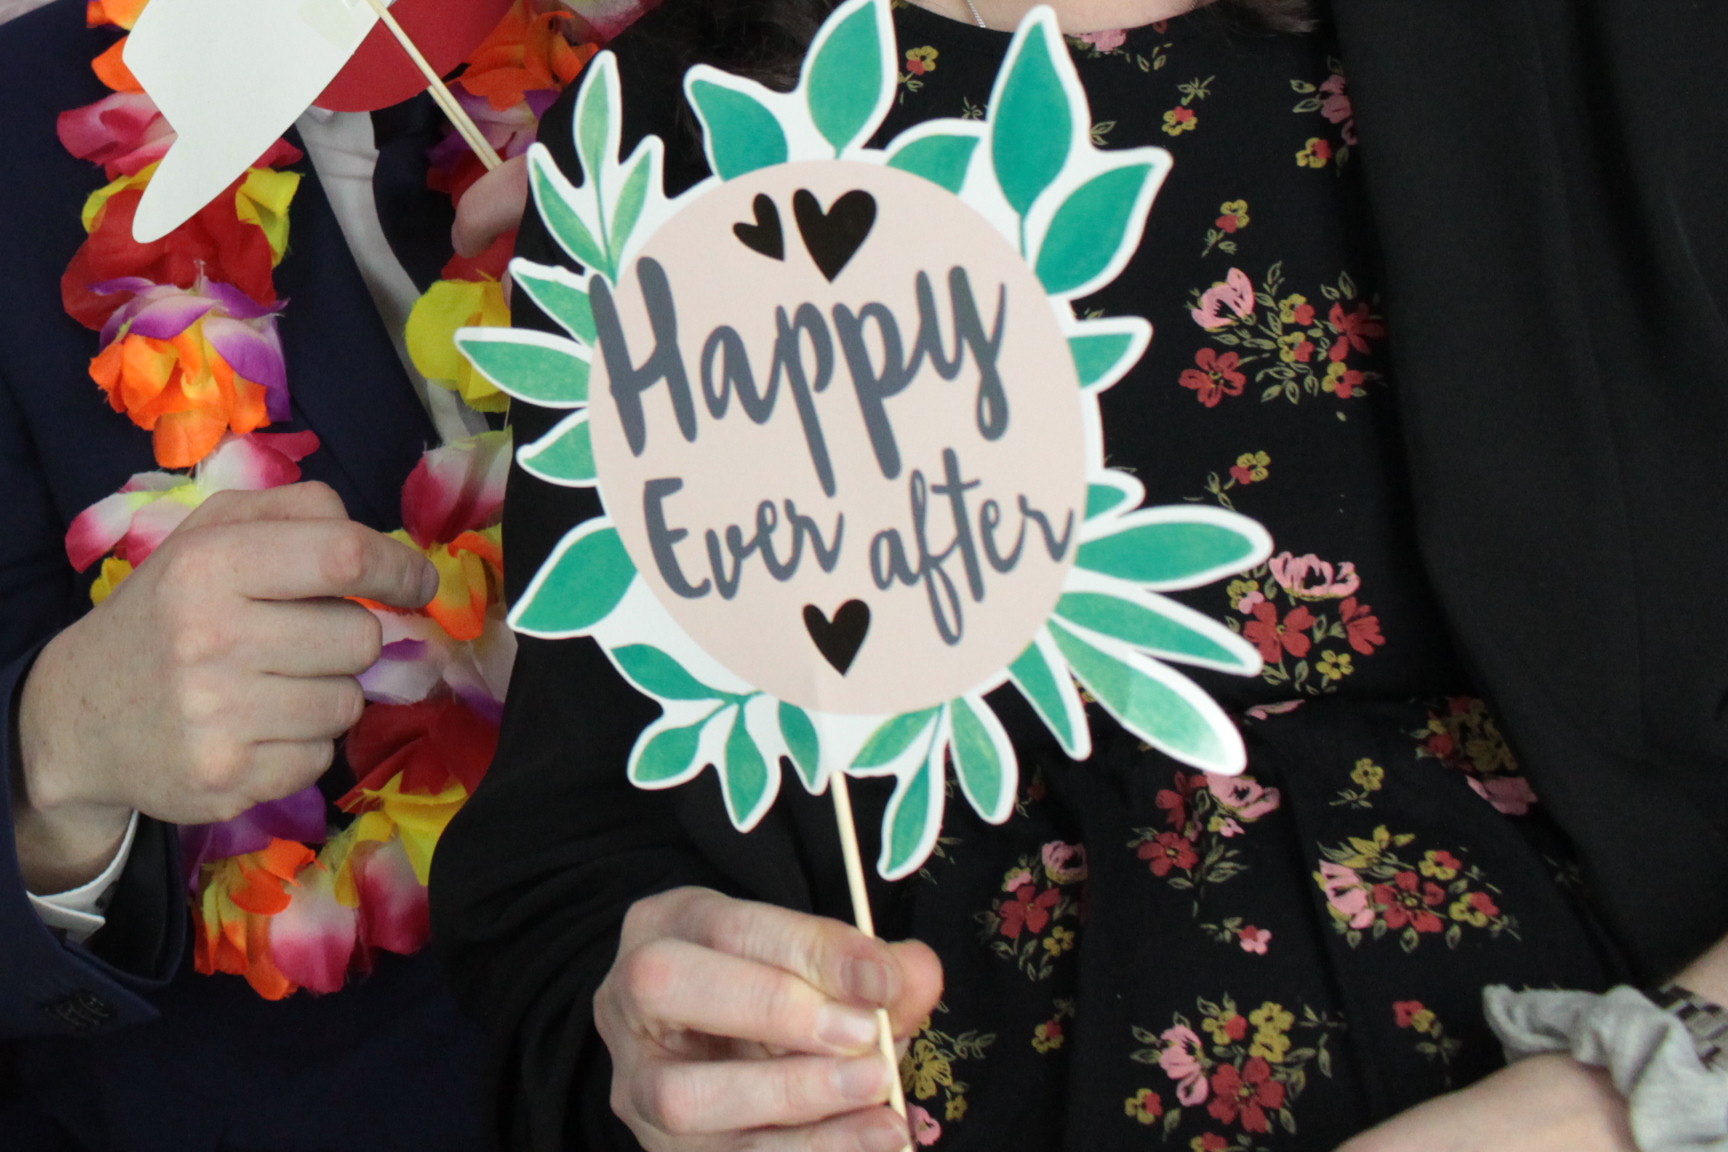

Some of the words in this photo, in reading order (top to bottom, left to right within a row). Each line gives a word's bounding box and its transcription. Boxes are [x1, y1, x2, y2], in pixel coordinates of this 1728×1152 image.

[589, 256, 1008, 497] Happy
[643, 477, 844, 600] Ever
[871, 448, 1073, 645] after
